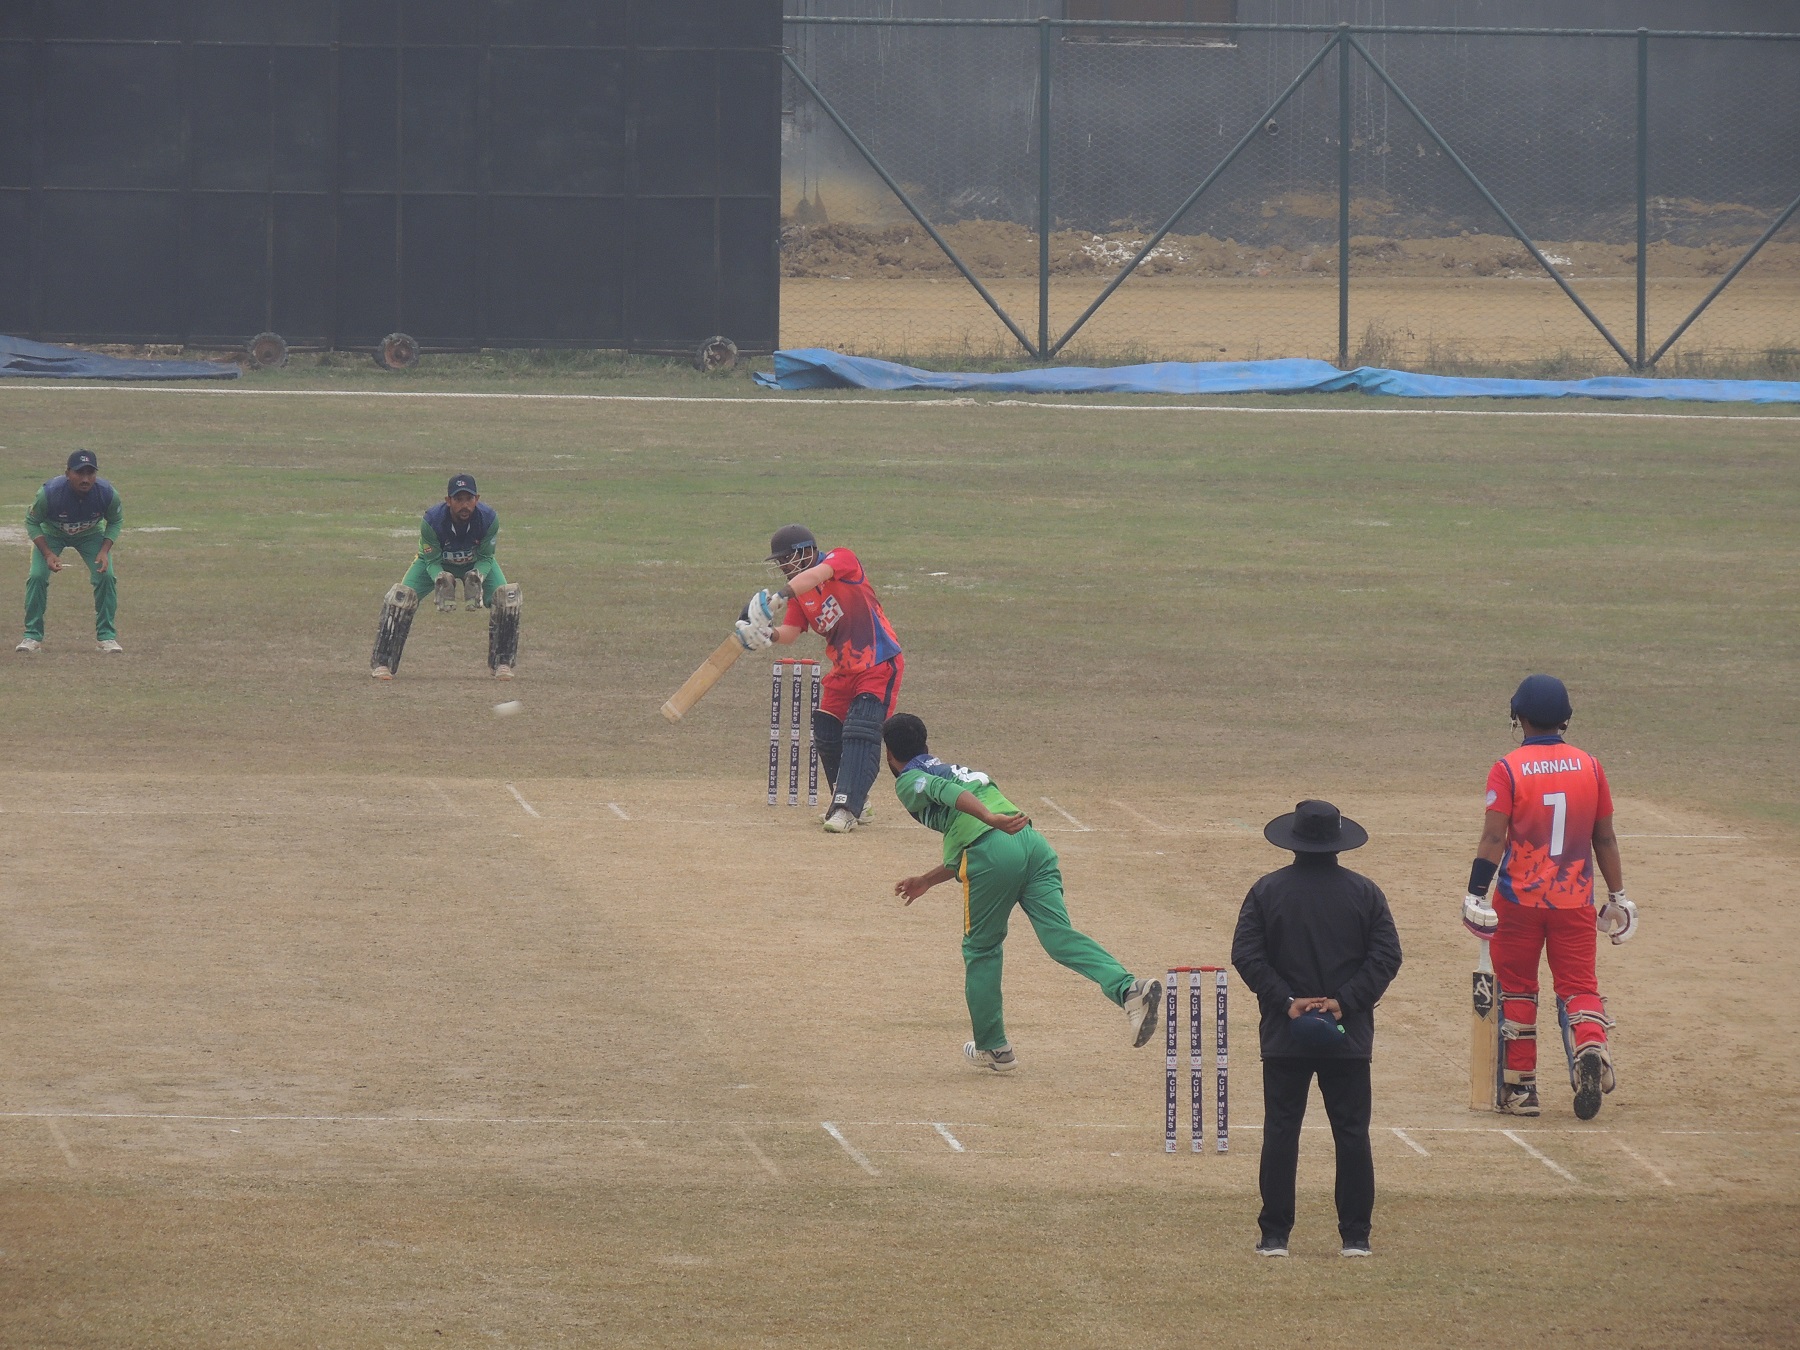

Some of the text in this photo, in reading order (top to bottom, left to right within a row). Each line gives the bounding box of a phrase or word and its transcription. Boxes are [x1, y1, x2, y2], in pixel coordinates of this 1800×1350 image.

[1521, 758, 1582, 776] KARNALI
[1168, 1020, 1176, 1046] MEN'S
[1191, 1020, 1200, 1046] MEN'S
[1218, 1019, 1226, 1045] MEN'S
[1168, 1103, 1176, 1129] MEN'S
[1193, 1103, 1201, 1129] MEN'S
[1218, 1102, 1226, 1127] MEN'S
